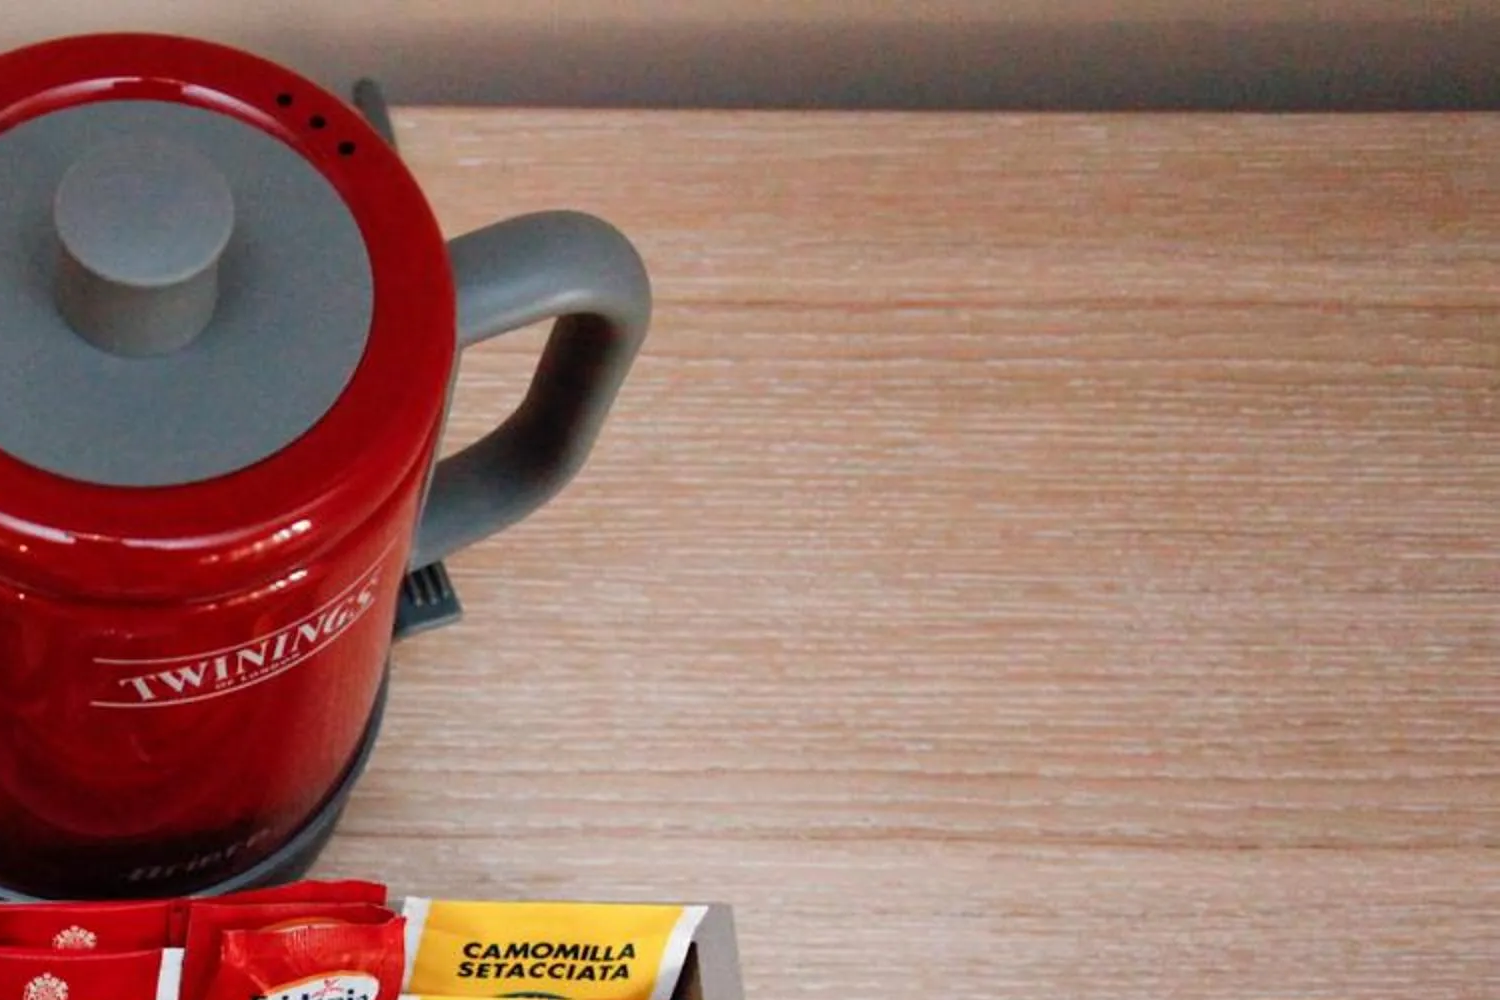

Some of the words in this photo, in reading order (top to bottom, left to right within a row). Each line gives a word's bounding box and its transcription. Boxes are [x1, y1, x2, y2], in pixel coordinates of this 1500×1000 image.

[118, 578, 378, 701] TWININGS
[463, 942, 636, 961] CAMOMILLA
[457, 962, 629, 981] SETACCIATA
